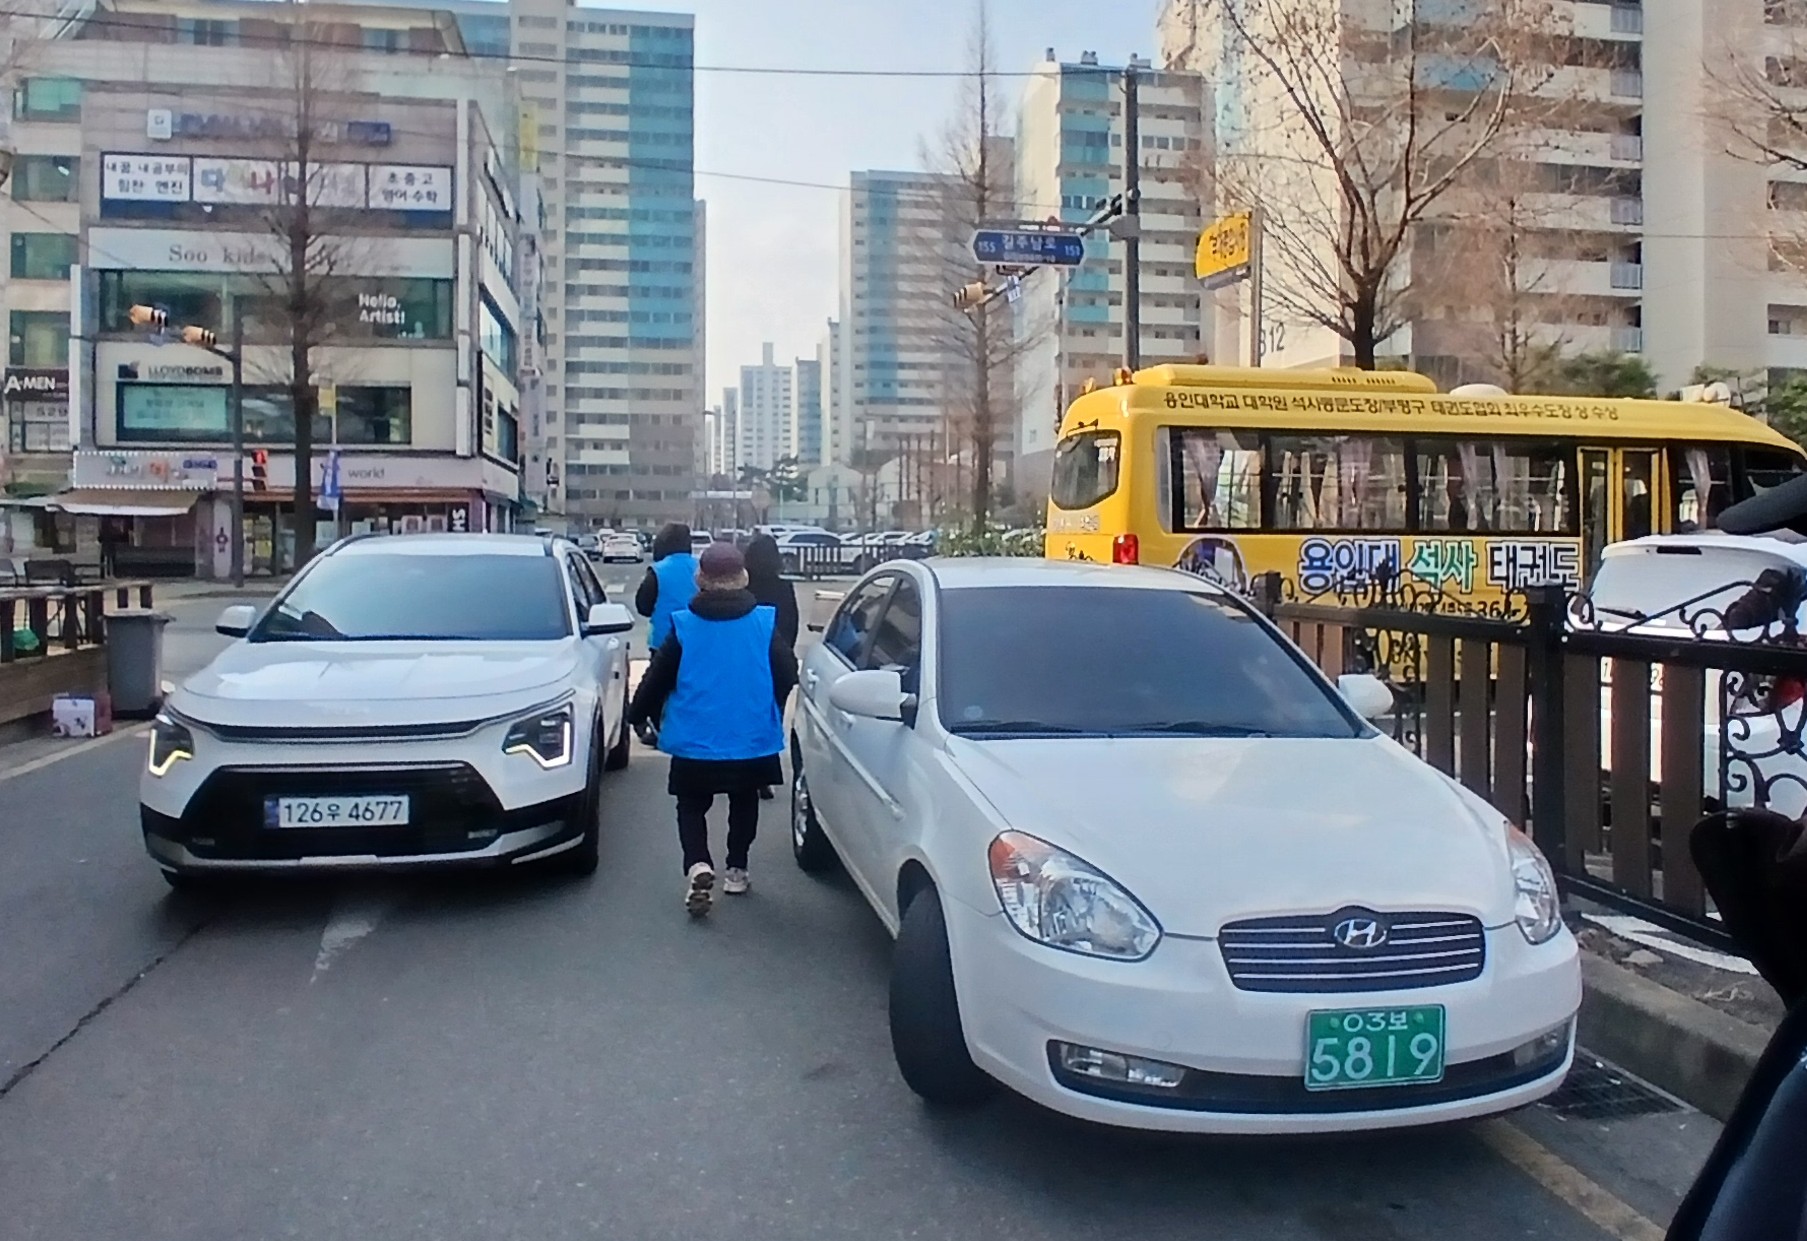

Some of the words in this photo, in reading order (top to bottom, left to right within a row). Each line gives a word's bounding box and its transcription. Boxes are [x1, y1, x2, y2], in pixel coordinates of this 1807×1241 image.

[168, 244, 208, 263] Soo
[359, 310, 405, 325] Artist!
[1164, 391, 1239, 409] 용인대학교
[1242, 394, 1288, 411] 대학원
[1430, 400, 1502, 416] 태권도협회
[348, 467, 385, 478] world
[1298, 538, 1401, 595] 용인대
[1405, 539, 1479, 594] 석사
[1486, 541, 1581, 594] 태권도
[284, 802, 340, 823] 126우
[348, 801, 402, 821] 4677
[1343, 1011, 1408, 1032] 03보
[1311, 1032, 1438, 1082] 5819
